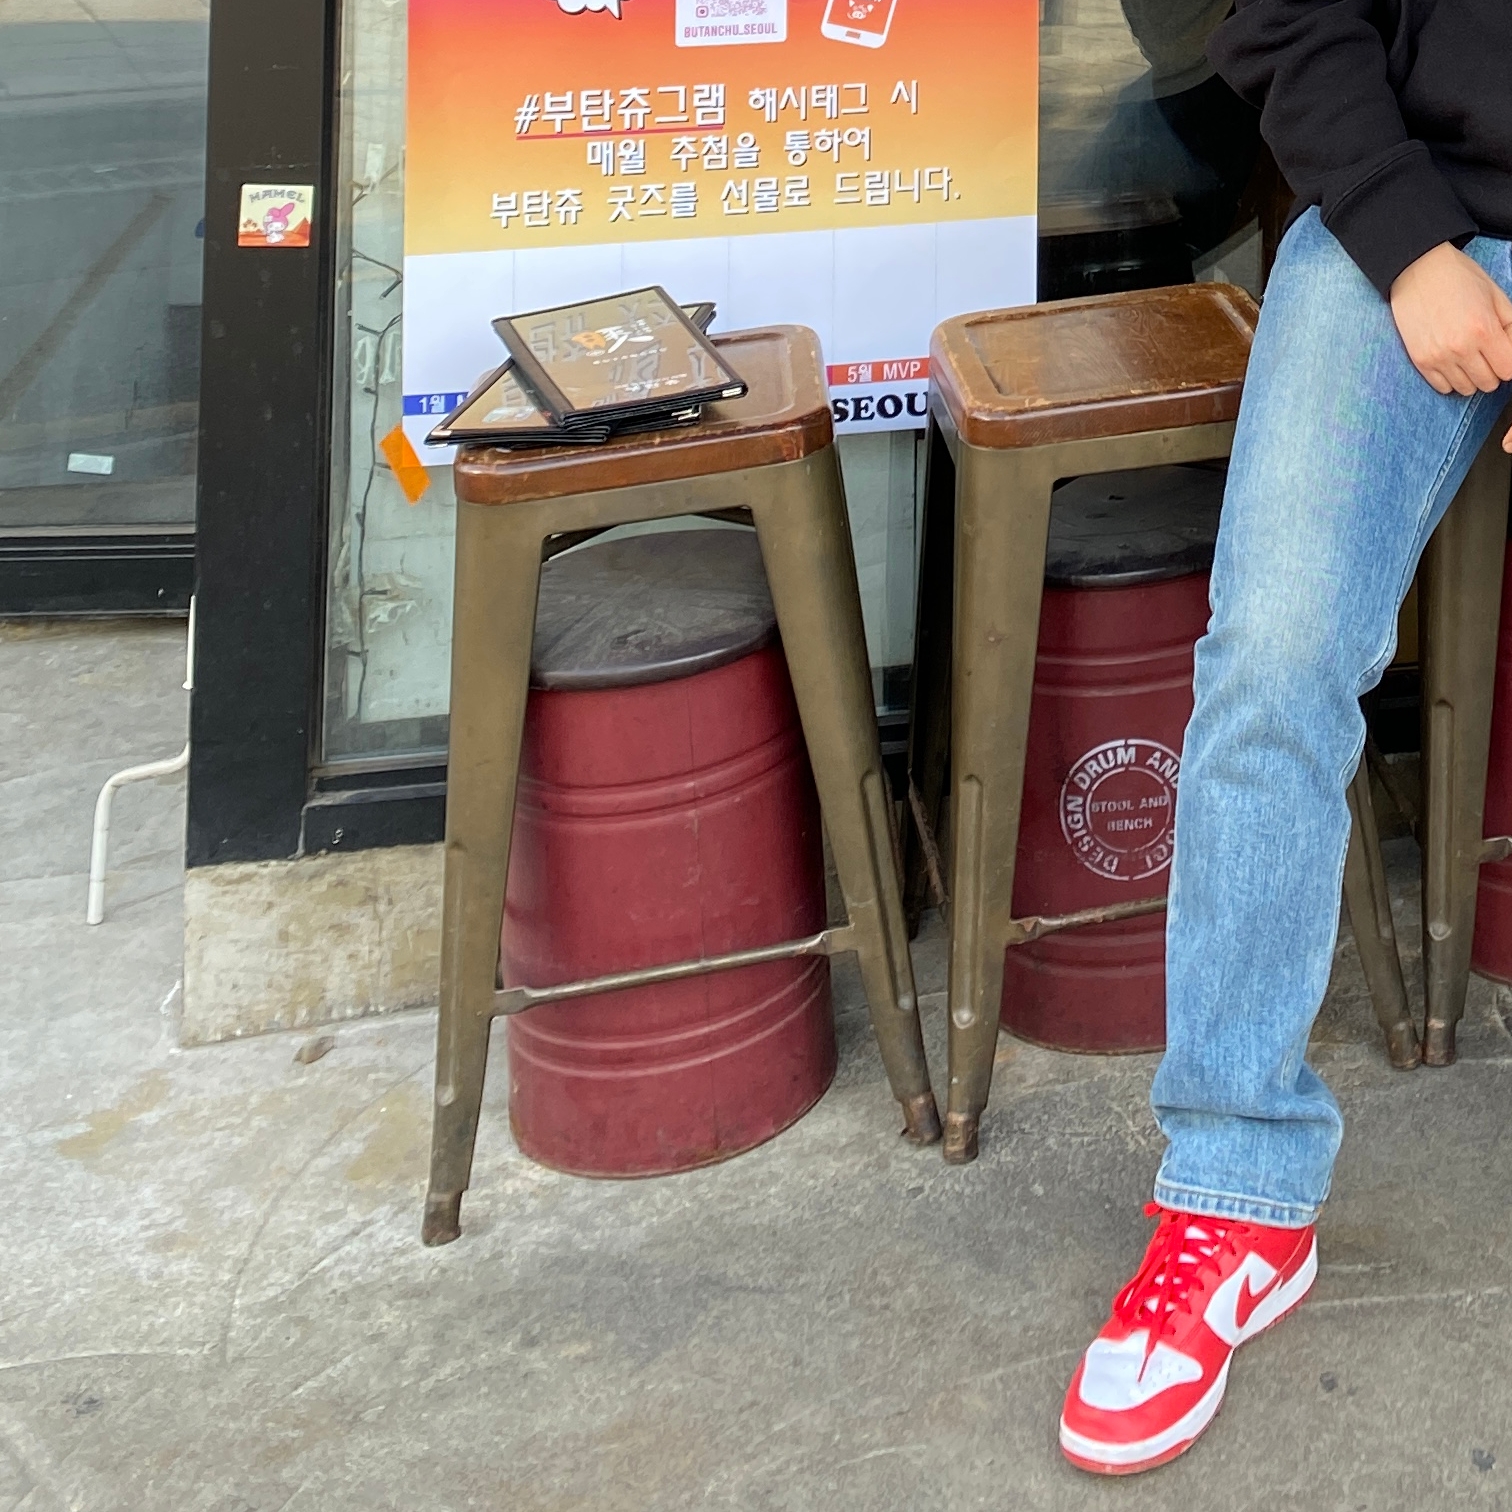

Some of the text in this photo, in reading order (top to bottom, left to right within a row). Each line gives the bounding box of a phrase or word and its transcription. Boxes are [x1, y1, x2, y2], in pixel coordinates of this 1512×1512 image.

[684, 23, 777, 38] BUTANCHU_SEOUL
[514, 80, 918, 135] #부탄츄그램 해시태그 시
[587, 127, 871, 176] 매월 추첨을 통하여
[608, 181, 699, 223] 굿즈를
[721, 174, 811, 214] 선물로
[847, 361, 921, 383] 5월 MVP
[419, 396, 446, 414] 1월
[831, 392, 928, 423] SEOU
[1074, 746, 1136, 790] DRUM
[1139, 795, 1169, 809] AND
[1067, 795, 1118, 873] DESIGN
[1107, 817, 1153, 832] BENCH
